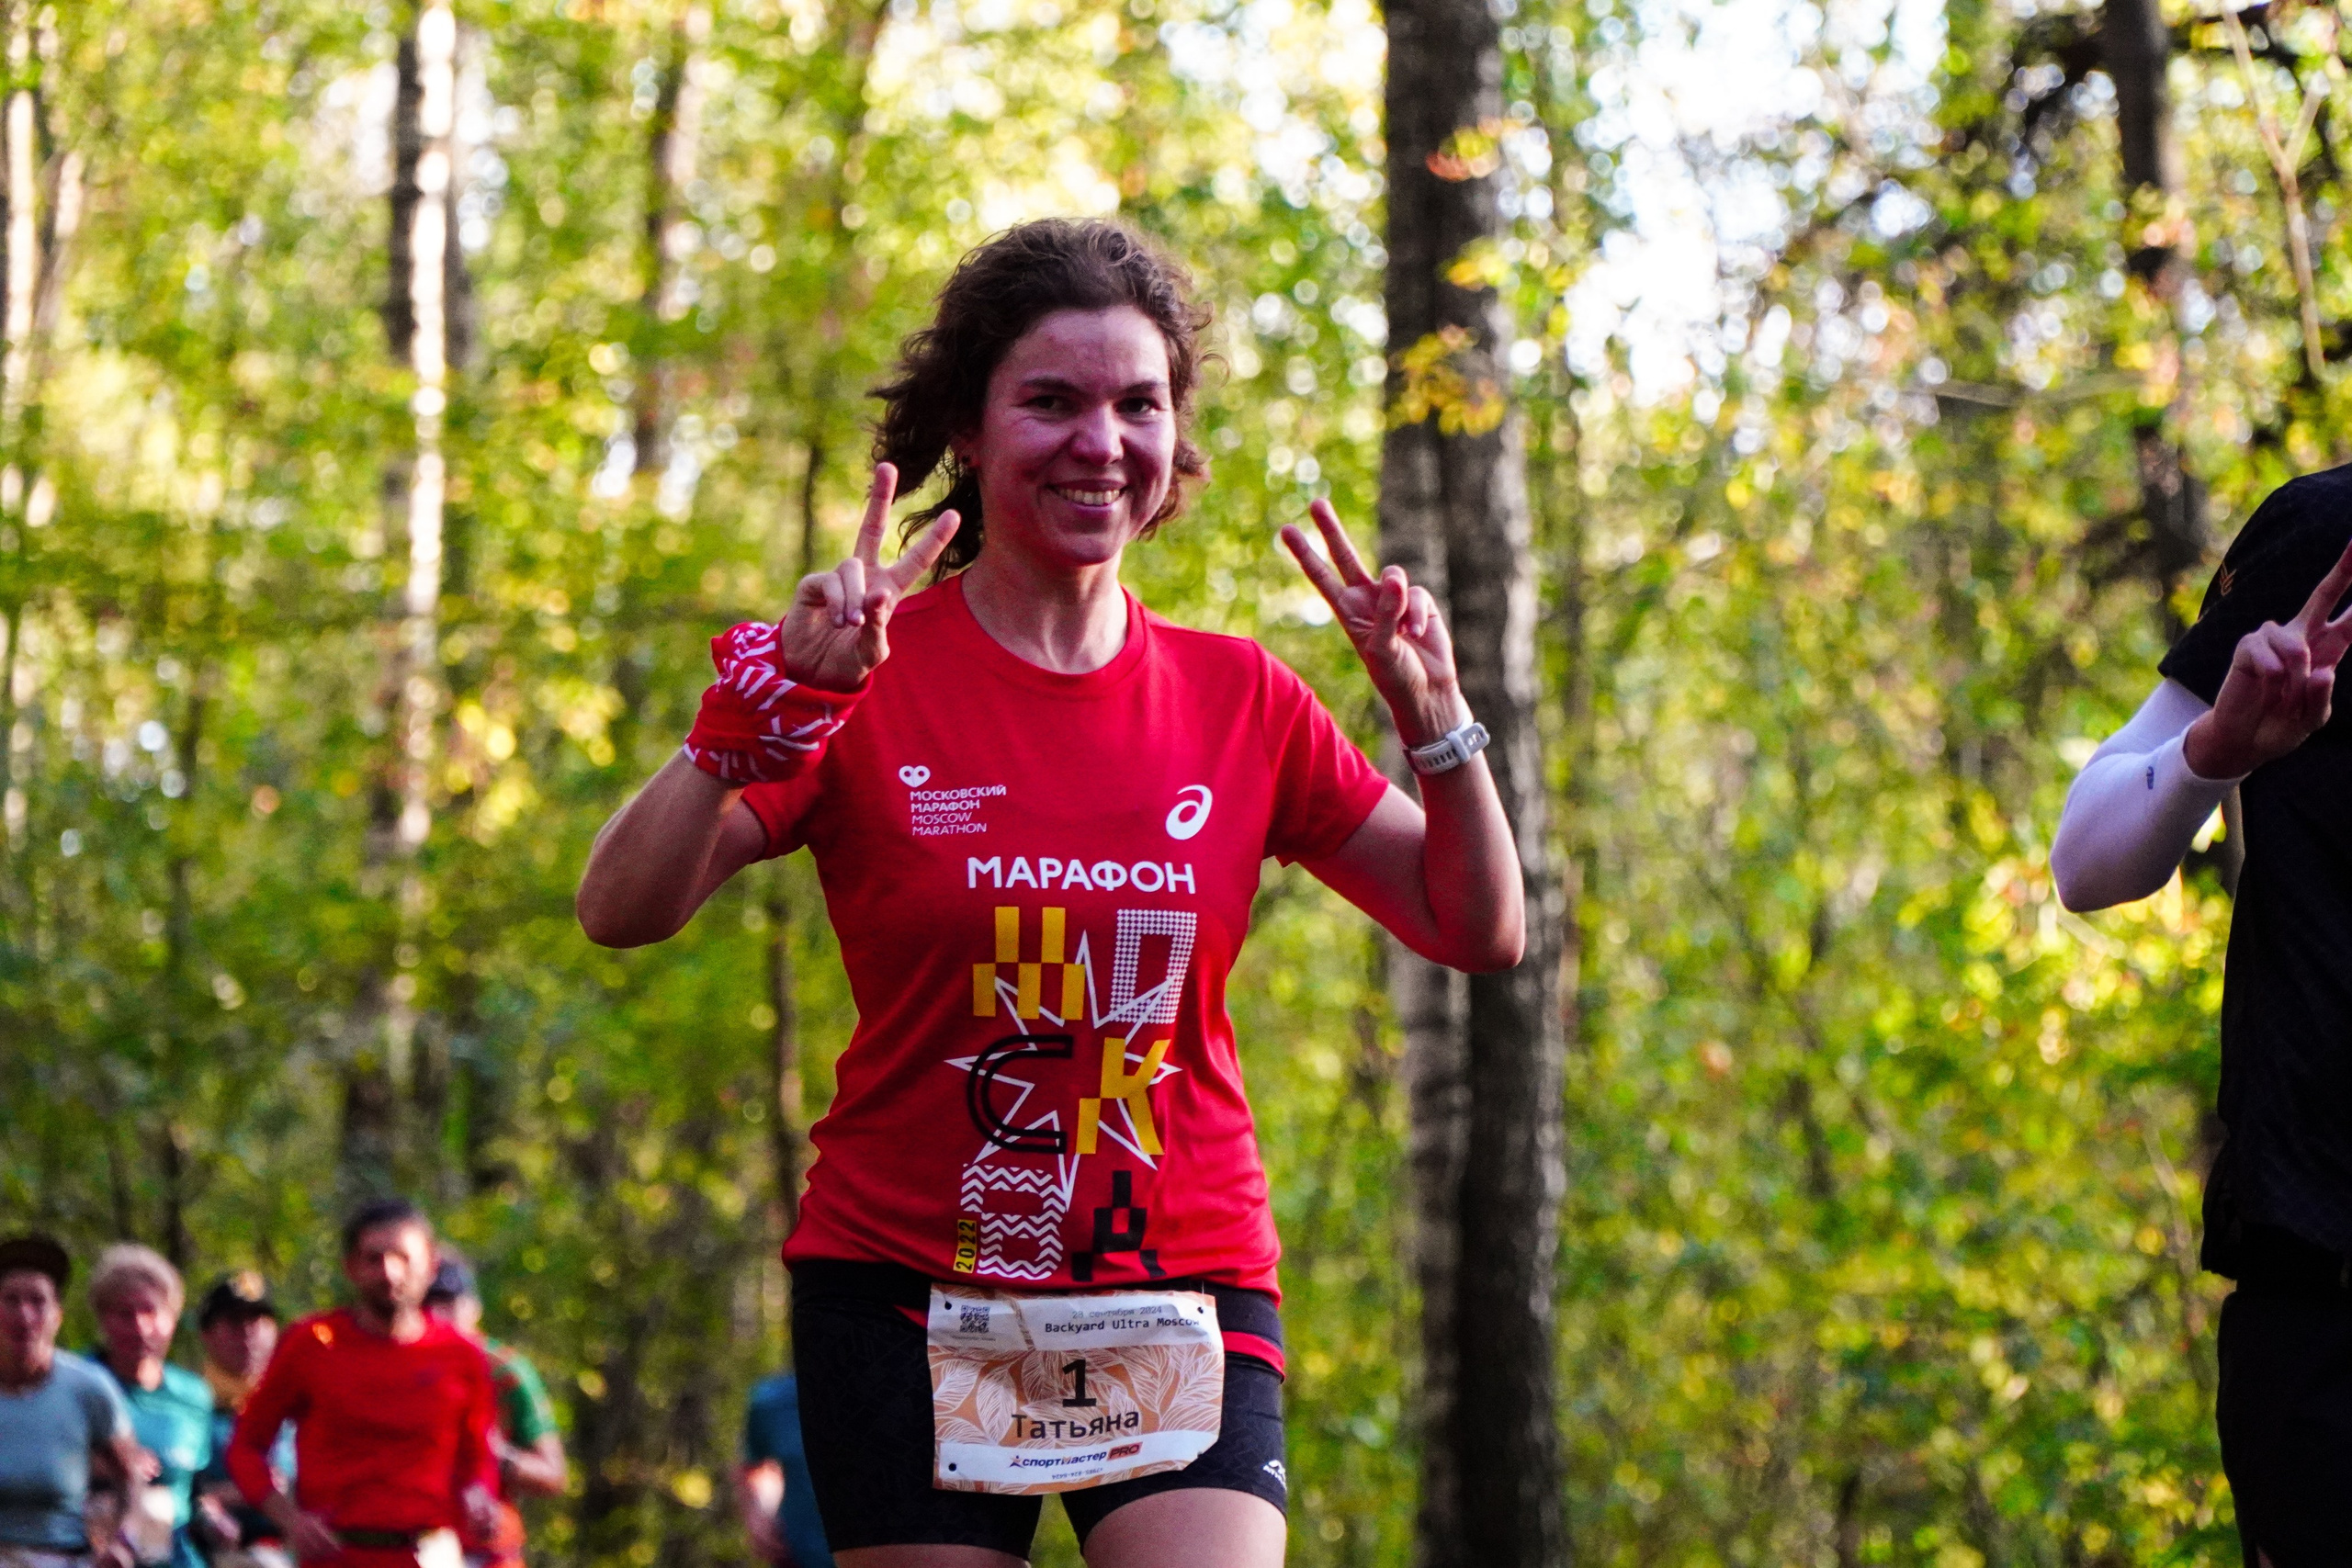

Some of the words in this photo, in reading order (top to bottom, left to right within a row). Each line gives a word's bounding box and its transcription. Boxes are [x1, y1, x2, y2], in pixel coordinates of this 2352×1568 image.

[910, 784, 1007, 801] МОСКОВСКИЙ
[910, 799, 980, 813] МАРАФОН
[911, 812, 972, 825] MOSCOW
[912, 823, 988, 836] MARATHON
[967, 856, 1196, 895] МАРАФОН
[956, 1221, 976, 1271] 2022
[1139, 1305, 1162, 1314] 2024
[1045, 1321, 1105, 1334] Backyard
[1112, 1317, 1149, 1329] Ultra
[1062, 1359, 1097, 1407] 1
[1012, 1411, 1139, 1439] Татьяна
[1109, 1444, 1140, 1459] PRO
